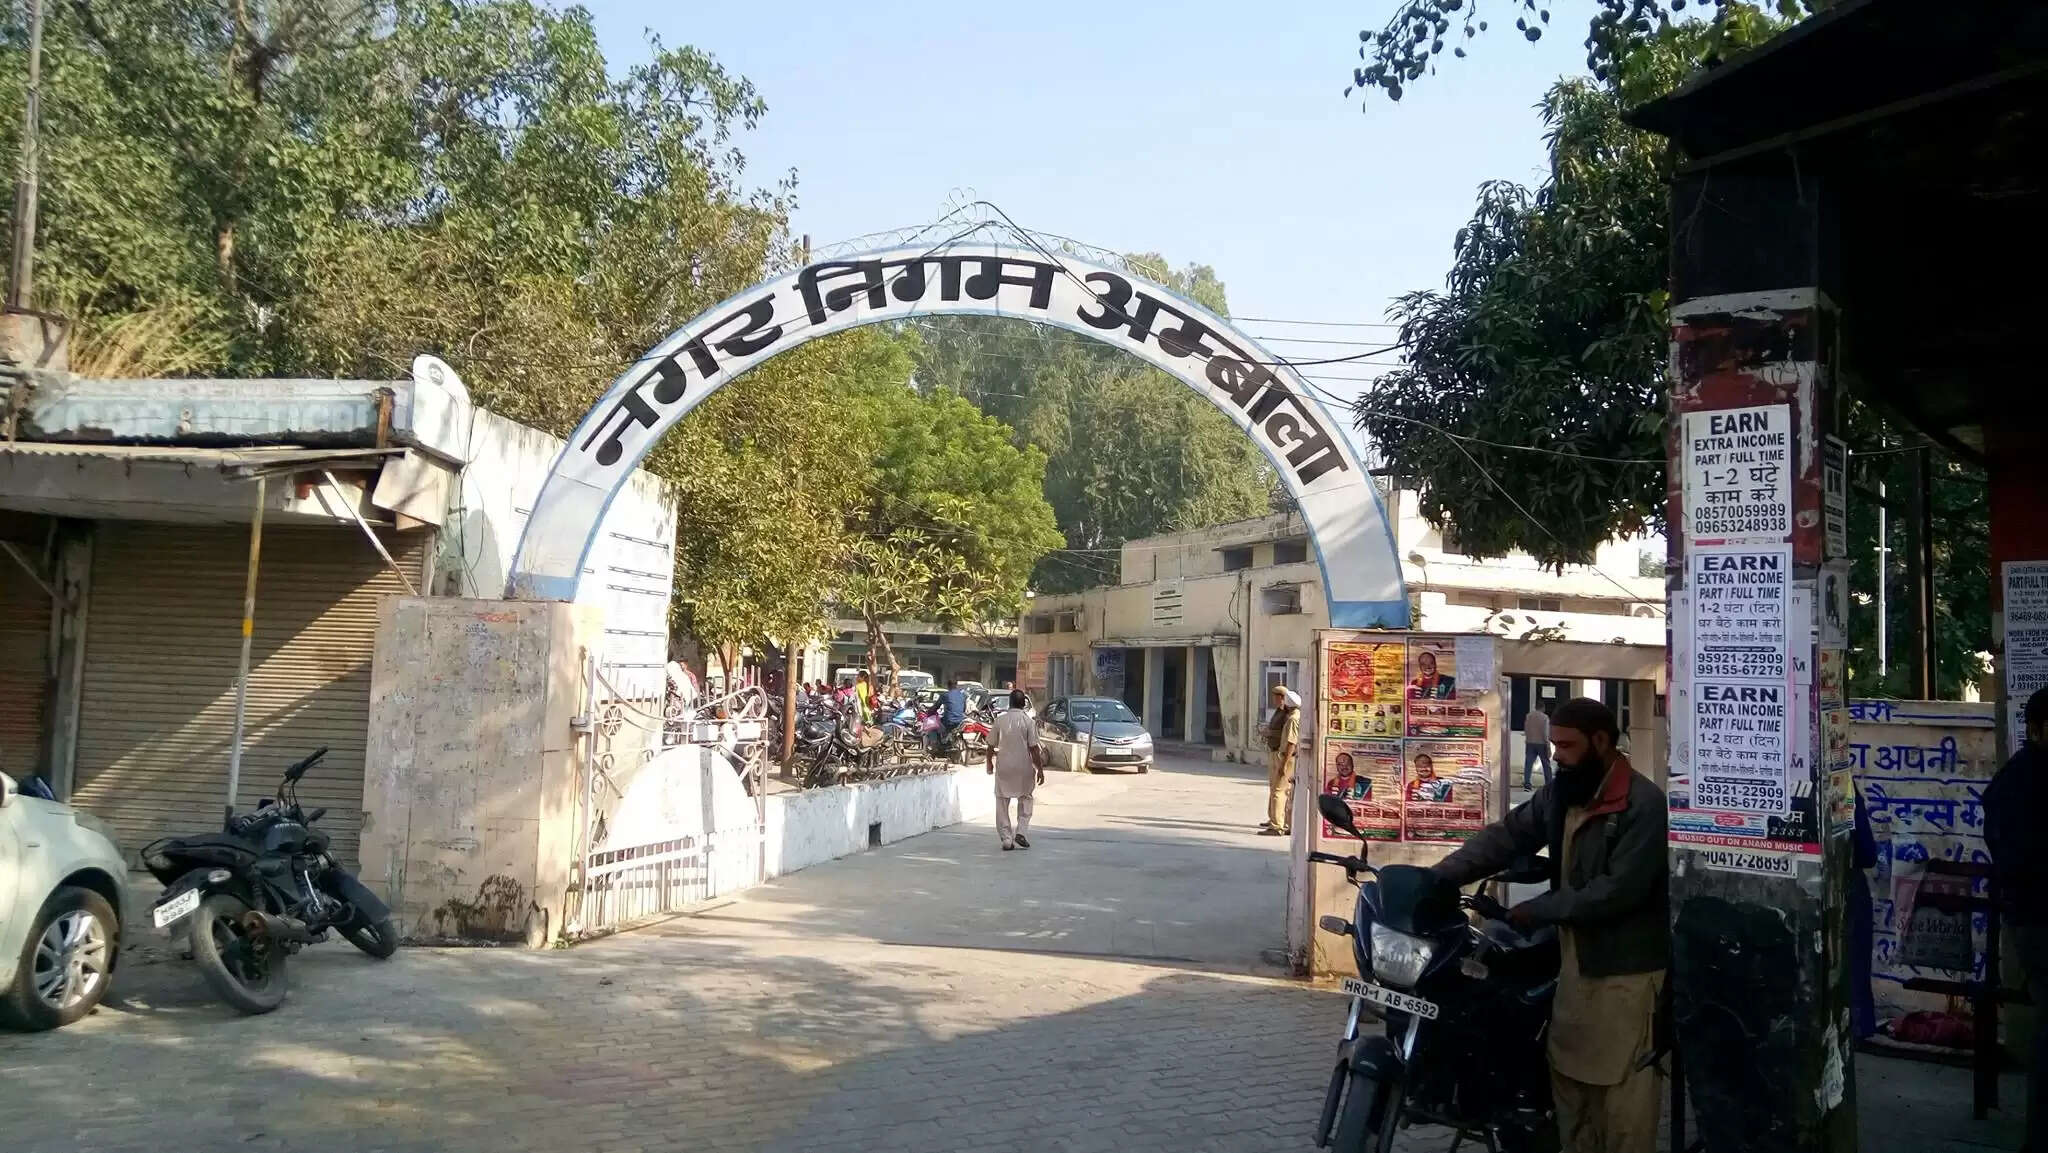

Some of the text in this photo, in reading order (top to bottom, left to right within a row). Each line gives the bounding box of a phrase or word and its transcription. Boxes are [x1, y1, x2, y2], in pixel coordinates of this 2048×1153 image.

[580, 256, 1350, 486] नगर निगम अम्बाला
[1711, 411, 1768, 435] EARN
[1694, 433, 1785, 451] EXTRA INCOME
[1695, 454, 1721, 466] PART
[1730, 452, 1755, 463] FULL
[1758, 450, 1784, 461] TIME
[1703, 462, 1780, 487] 1-2 घंटे
[1705, 484, 1778, 504] काम करें
[1695, 503, 1786, 519] 08570059989
[1695, 518, 1786, 533] 09653248938
[1704, 556, 1778, 570] EARN
[1697, 572, 1783, 584] EXTRA INCOME
[1700, 588, 1723, 599] PART
[1731, 587, 1754, 599] FULL
[1757, 587, 1780, 599] TIME
[1700, 603, 1720, 613] 1-2
[1724, 601, 1744, 612] घंटा
[1698, 619, 1712, 628] घर
[1736, 619, 1757, 628] काम
[1697, 653, 1783, 664] 95921-22909
[1697, 664, 1783, 675] 99155-67279
[1703, 686, 1778, 703] EARN
[1697, 703, 1783, 717] EXTRA INCOME
[1700, 717, 1723, 729] PART
[1731, 718, 1754, 731] FULL
[1757, 720, 1780, 732] TIME
[1700, 733, 1720, 744] 1-2
[1724, 733, 1744, 745] घंटा
[1698, 749, 1712, 758] घर
[1736, 750, 1758, 760] काम
[1874, 735, 1958, 774] अपनी
[1697, 783, 1783, 798] 95921-22909
[1697, 795, 1783, 810] 99155-67279
[1678, 834, 1705, 842] MUSIC
[1706, 836, 1726, 845] OUT
[1727, 838, 1741, 846] ON
[1774, 843, 1803, 852] MUSIC
